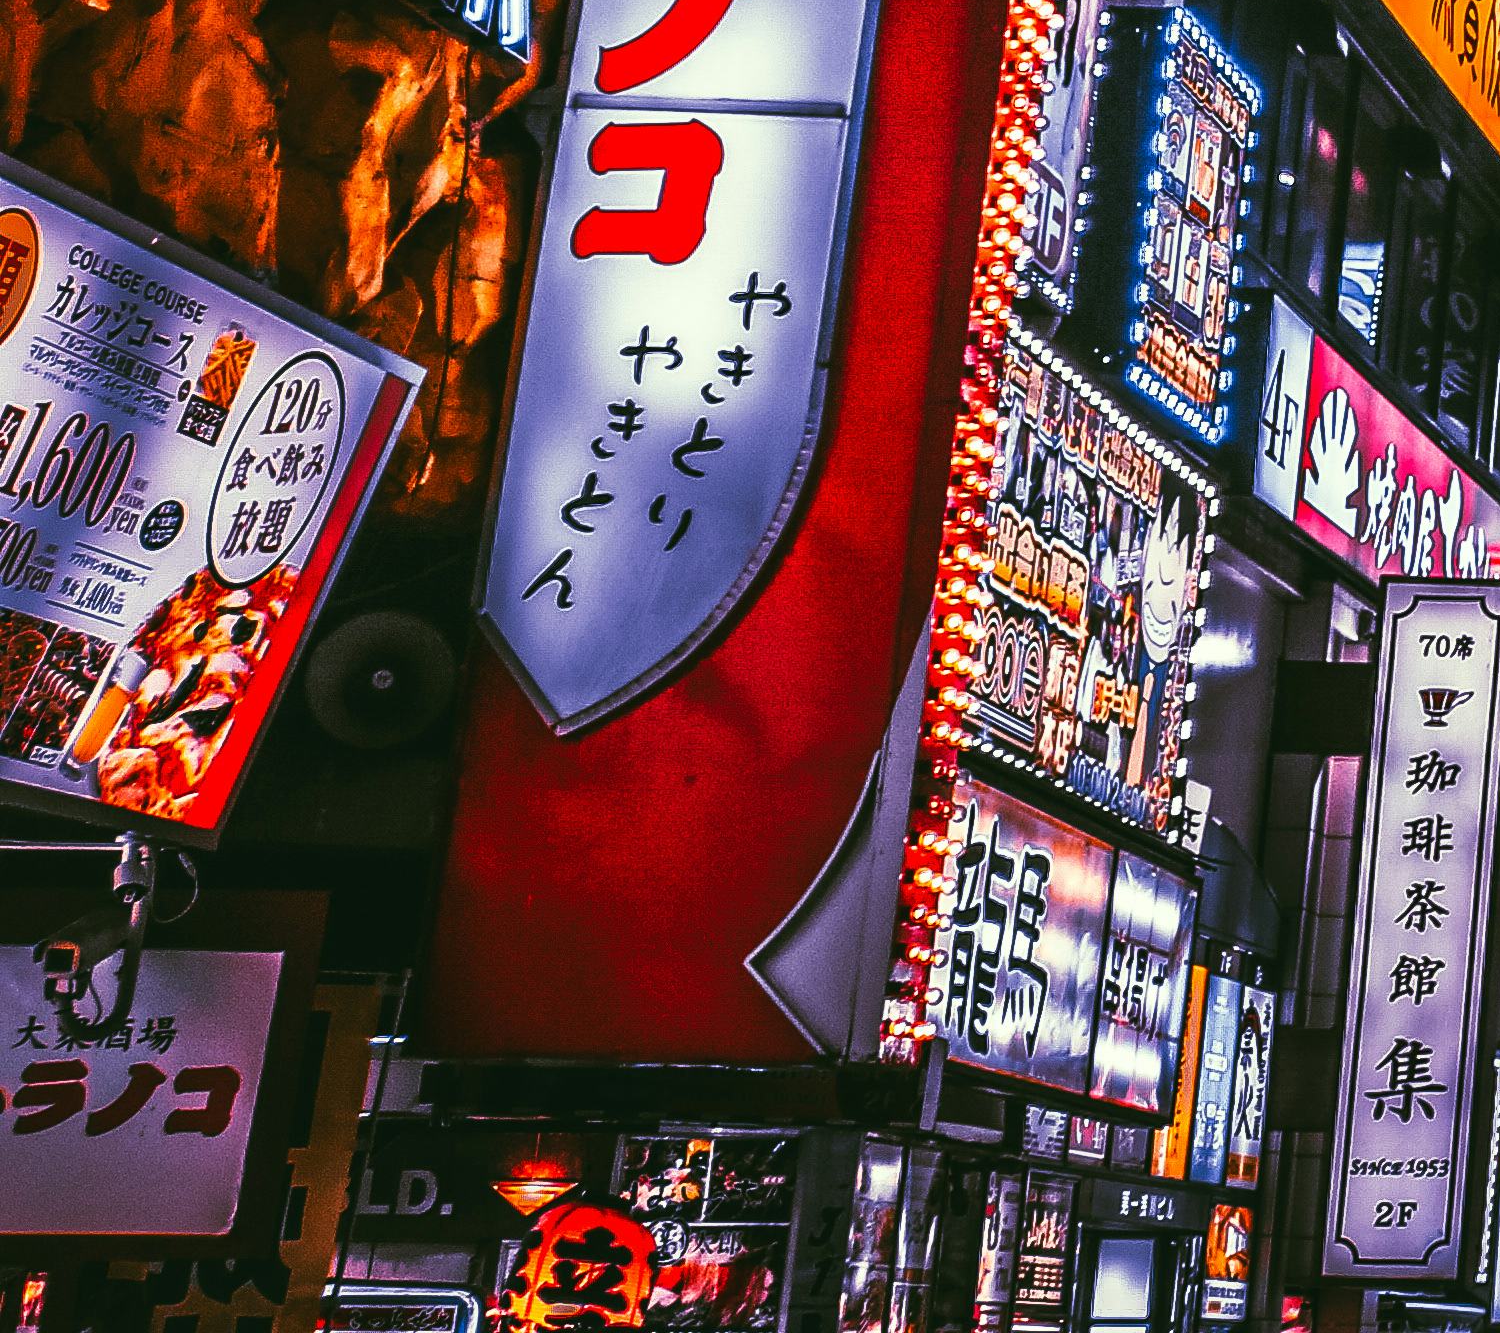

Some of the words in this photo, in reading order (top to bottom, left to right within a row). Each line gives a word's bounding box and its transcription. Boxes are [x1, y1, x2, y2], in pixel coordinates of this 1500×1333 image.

[50, 274, 195, 373] カレッジコース
[66, 244, 144, 296] COLLEGE
[142, 280, 209, 327] COURSE
[262, 374, 333, 439] 120分
[650, 272, 792, 552] やきとり
[1261, 346, 1300, 473] 4F
[228, 440, 325, 493] 食べ飲み
[522, 325, 684, 610] やきとん
[219, 495, 299, 563] 放題
[1418, 634, 1476, 661] 70席
[1388, 748, 1462, 1008] 珈琲茶館
[1364, 1037, 1450, 1125] 集
[1349, 1157, 1403, 1178] SINCE
[1403, 1157, 1452, 1179] 1953
[1373, 1201, 1419, 1229] 2F
